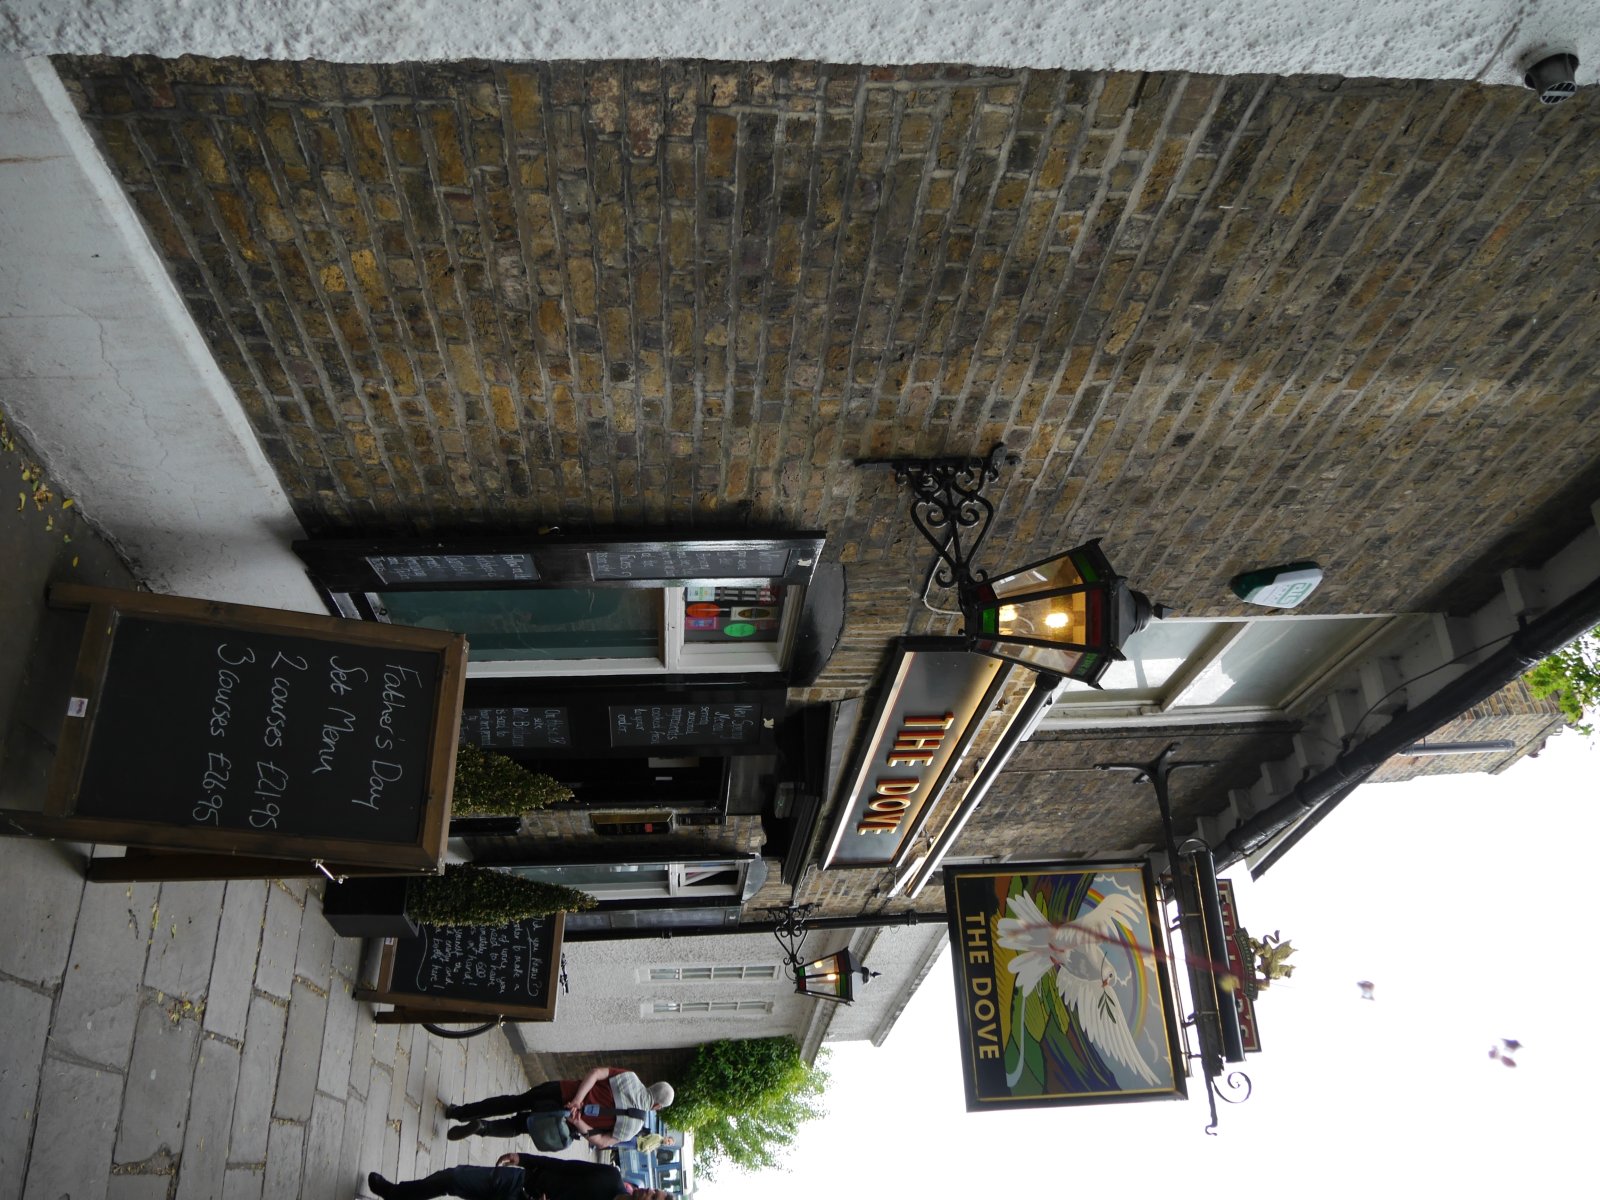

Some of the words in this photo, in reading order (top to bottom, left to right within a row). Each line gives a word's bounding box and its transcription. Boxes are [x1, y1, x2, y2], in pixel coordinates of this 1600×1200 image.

[217, 643, 256, 666] 3
[270, 651, 308, 671] 2
[329, 655, 369, 696] Set
[209, 669, 241, 737] courses
[264, 676, 292, 747] courses
[375, 663, 423, 749] Father's
[734, 705, 753, 718] New
[685, 711, 699, 735] seasonal
[311, 707, 356, 774] Menu
[887, 711, 955, 767] THE
[192, 752, 232, 827] £26.95
[248, 761, 289, 830] £21.95
[351, 760, 403, 810] Day
[857, 778, 920, 836] DOVE
[489, 928, 502, 948] need
[498, 934, 510, 944] of
[512, 920, 523, 940] rder
[965, 912, 990, 964] THE
[527, 937, 539, 952] you
[489, 953, 500, 961] to
[499, 948, 509, 969] wine
[512, 955, 523, 979] make
[444, 966, 454, 985] and
[475, 961, 488, 979] 600
[495, 976, 508, 994] you
[513, 983, 520, 992] a
[971, 977, 1000, 1059] DOVE
